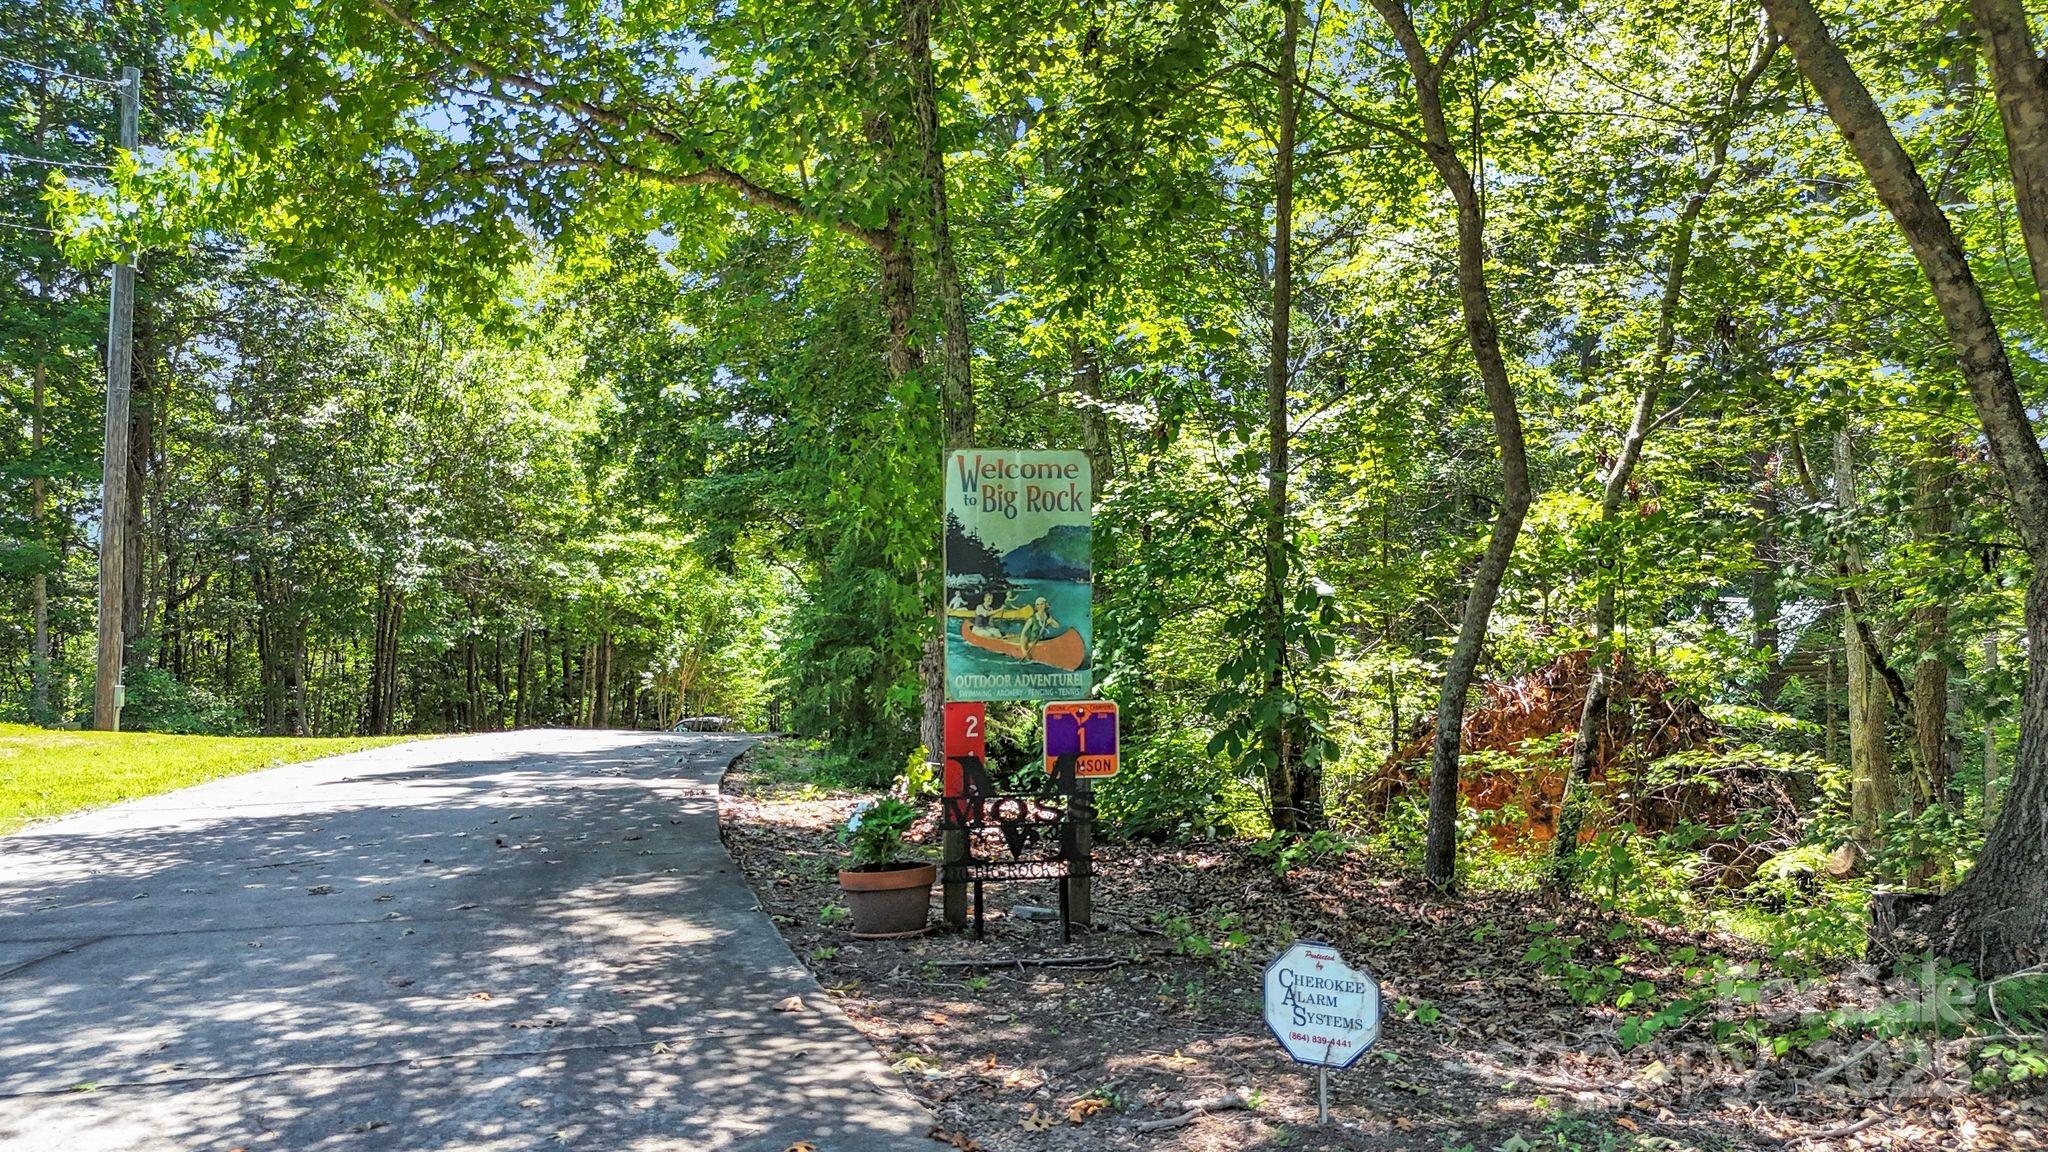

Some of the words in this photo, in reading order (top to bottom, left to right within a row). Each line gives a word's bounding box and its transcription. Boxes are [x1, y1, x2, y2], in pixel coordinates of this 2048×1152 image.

[956, 454, 1080, 493] Welcome
[964, 494, 978, 506] to
[982, 484, 1018, 519] Big
[1026, 483, 1084, 512] Rock
[955, 674, 1012, 688] OUTDOOR
[1058, 687, 1080, 696] TENNIS
[1305, 950, 1335, 961] Protected
[1315, 961, 1324, 971] by
[1278, 968, 1365, 994] CHEROKEE
[1281, 985, 1338, 1008] ALARM
[1292, 1004, 1363, 1031] SYSTEMS
[1289, 1031, 1310, 1043] (864)
